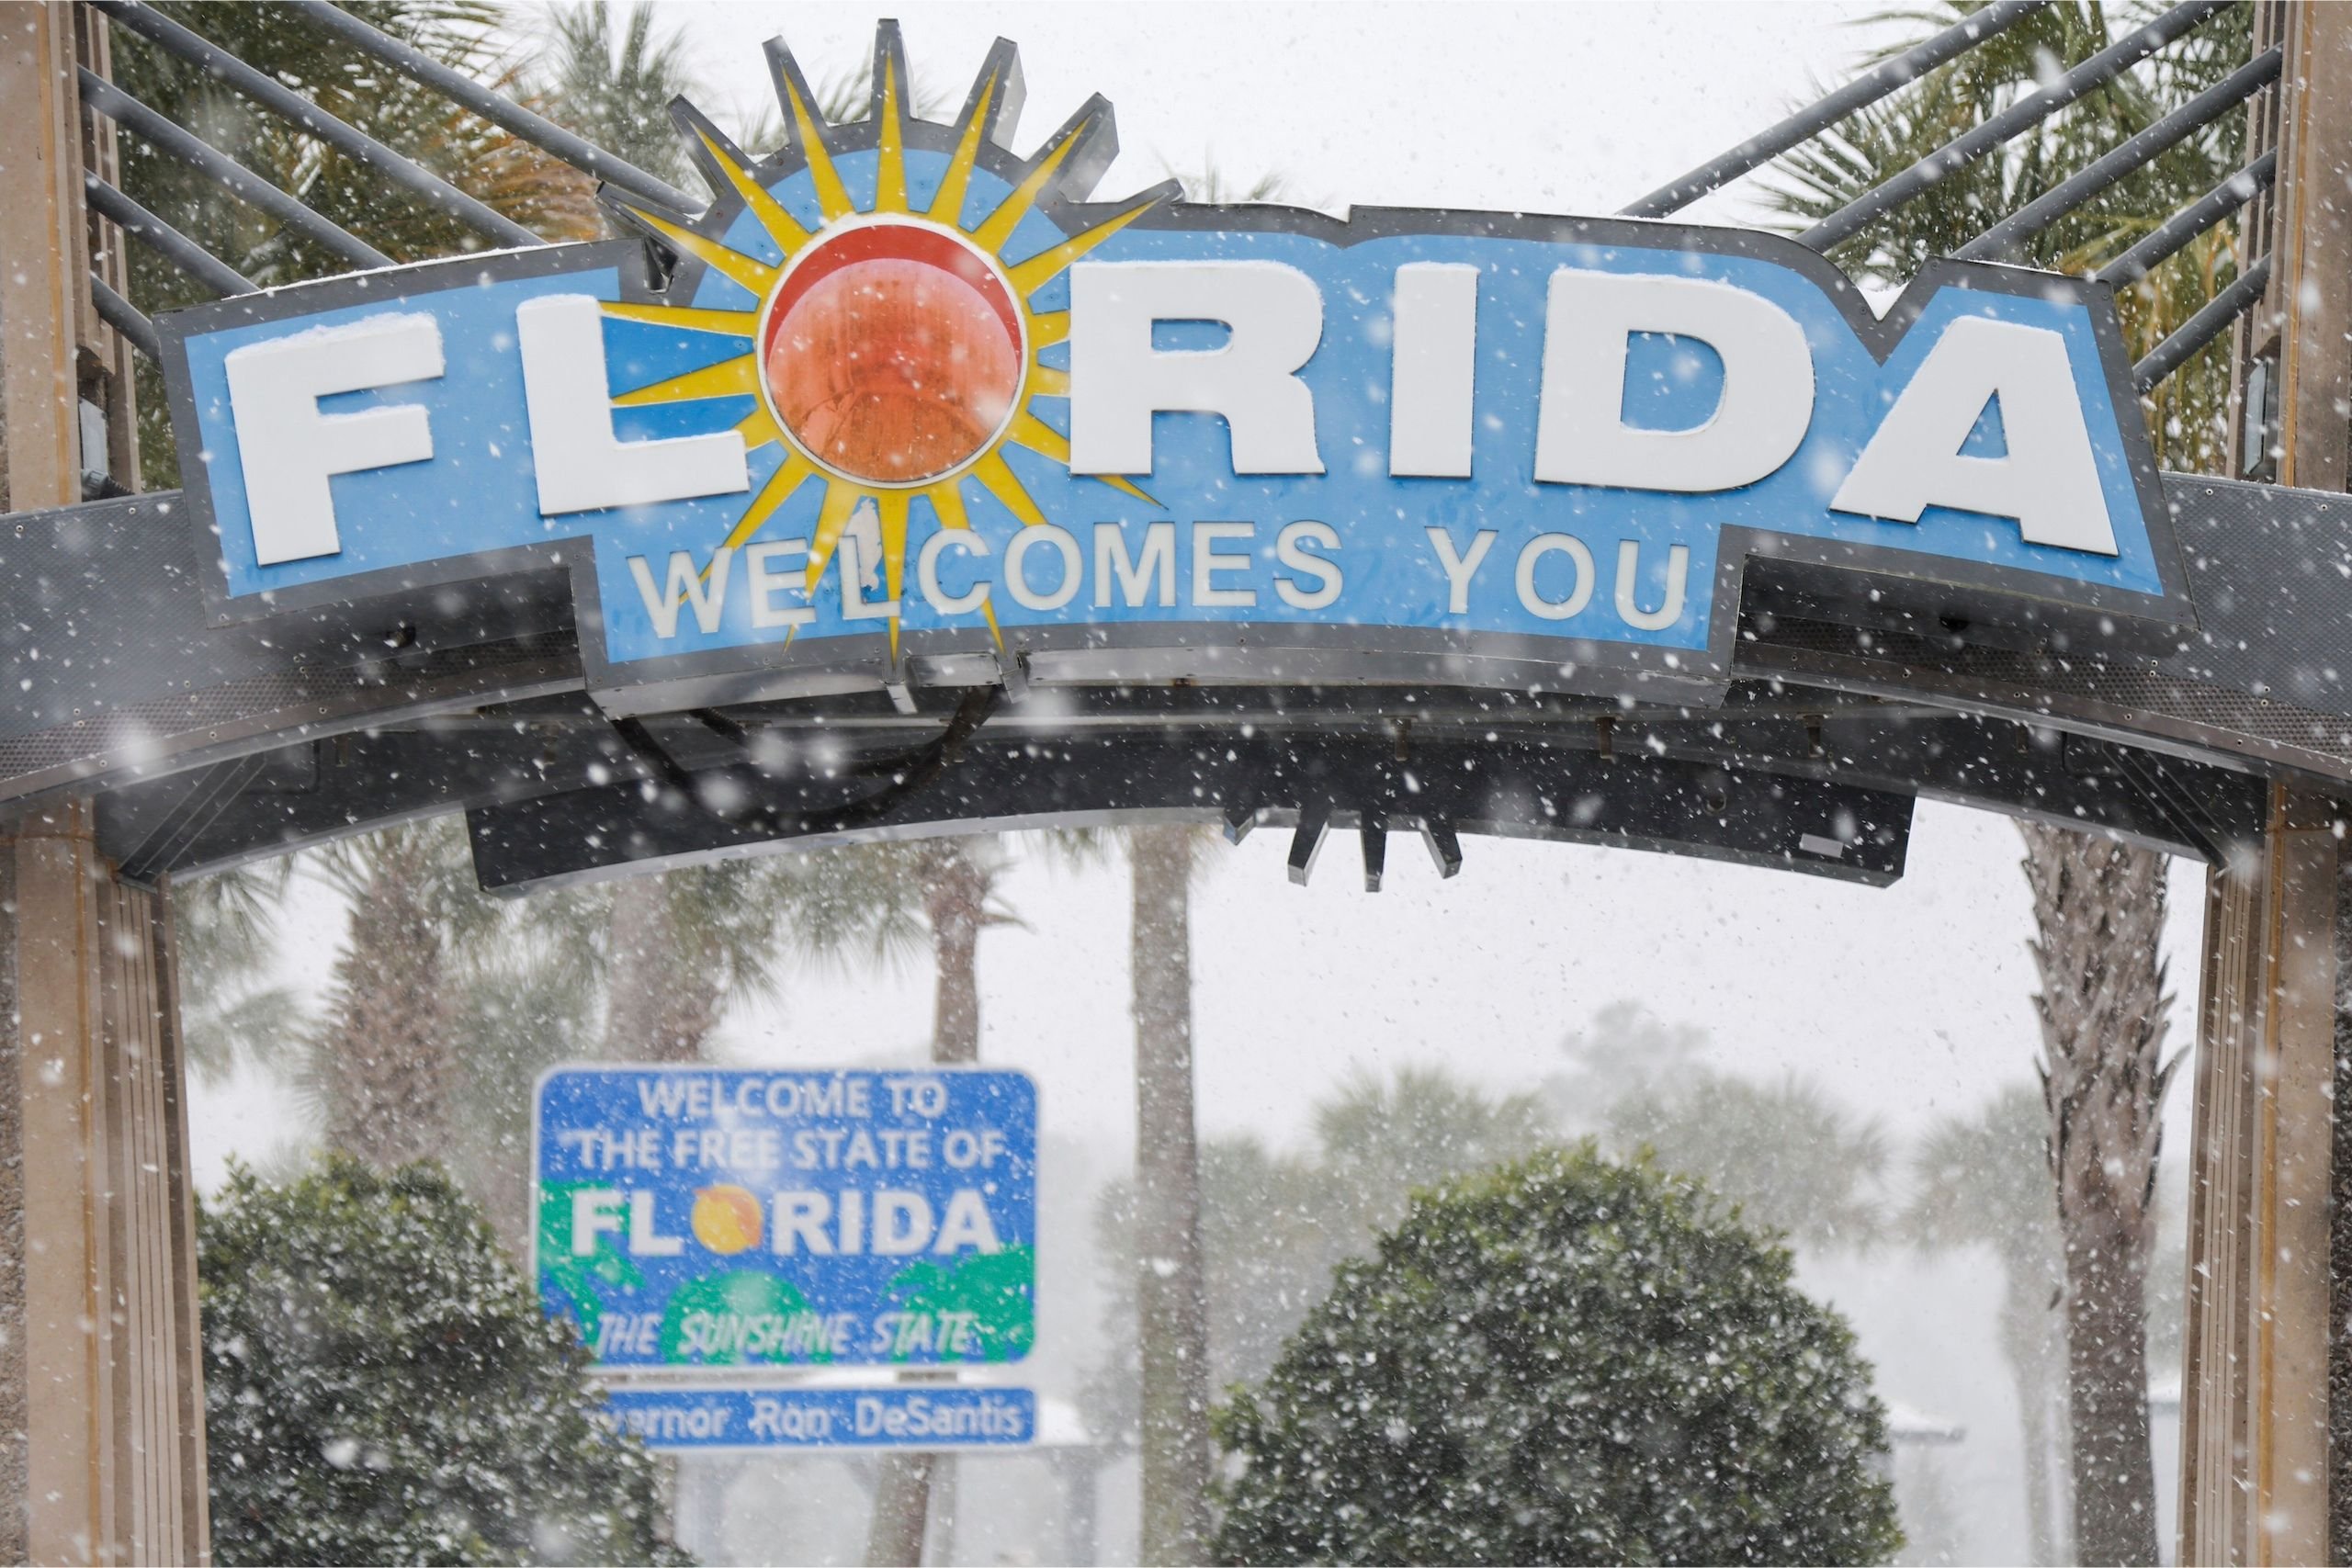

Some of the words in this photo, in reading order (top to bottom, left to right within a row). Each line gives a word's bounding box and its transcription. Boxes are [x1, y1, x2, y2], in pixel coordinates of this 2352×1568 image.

[224, 212, 2119, 566] FLORIDA
[628, 520, 1343, 637] WELCOMES
[1425, 526, 1688, 630] YOU
[639, 1078, 871, 1117] WELCOME
[885, 1078, 948, 1117] TO
[576, 1130, 662, 1169] THE
[673, 1130, 781, 1170] FREE
[793, 1130, 929, 1169] STATE
[944, 1130, 1005, 1169] OF
[571, 1185, 1001, 1256] FLORIDA
[597, 1314, 661, 1355] THE
[679, 1312, 854, 1355] SUNSHINE
[872, 1311, 978, 1355] STATE
[753, 1400, 829, 1437] Ron
[855, 1399, 1023, 1437] DeSantis
